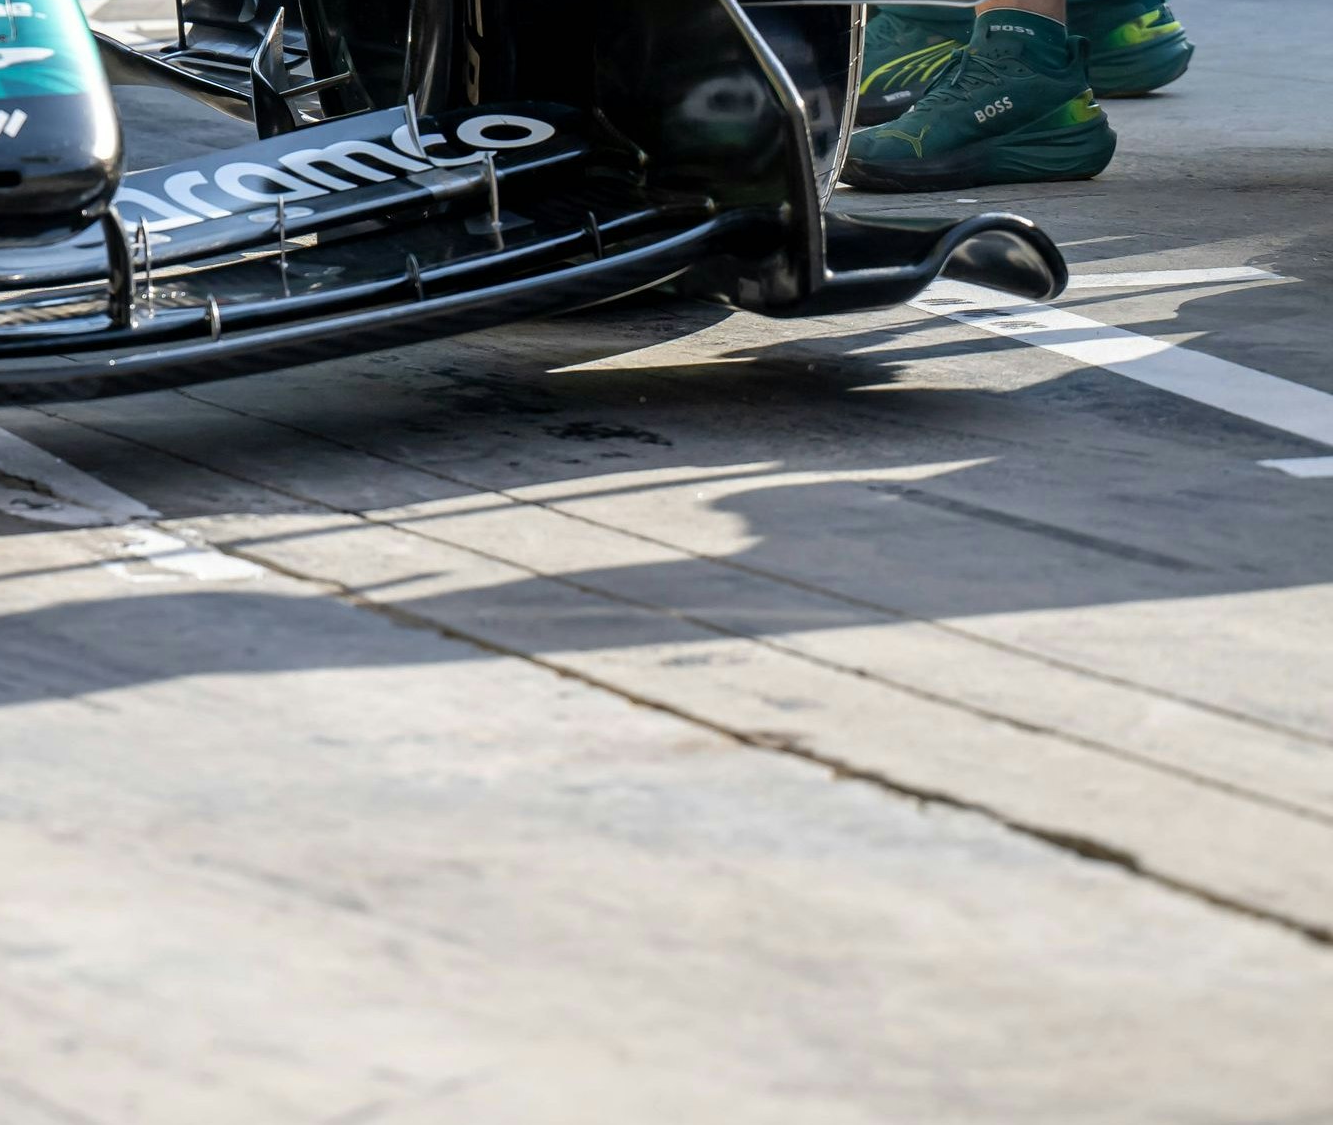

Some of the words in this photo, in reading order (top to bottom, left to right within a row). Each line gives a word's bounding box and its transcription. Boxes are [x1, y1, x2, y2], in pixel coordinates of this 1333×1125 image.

[989, 24, 1036, 37] BOSS
[973, 96, 1014, 124] BOSS
[116, 114, 556, 235] aramco
